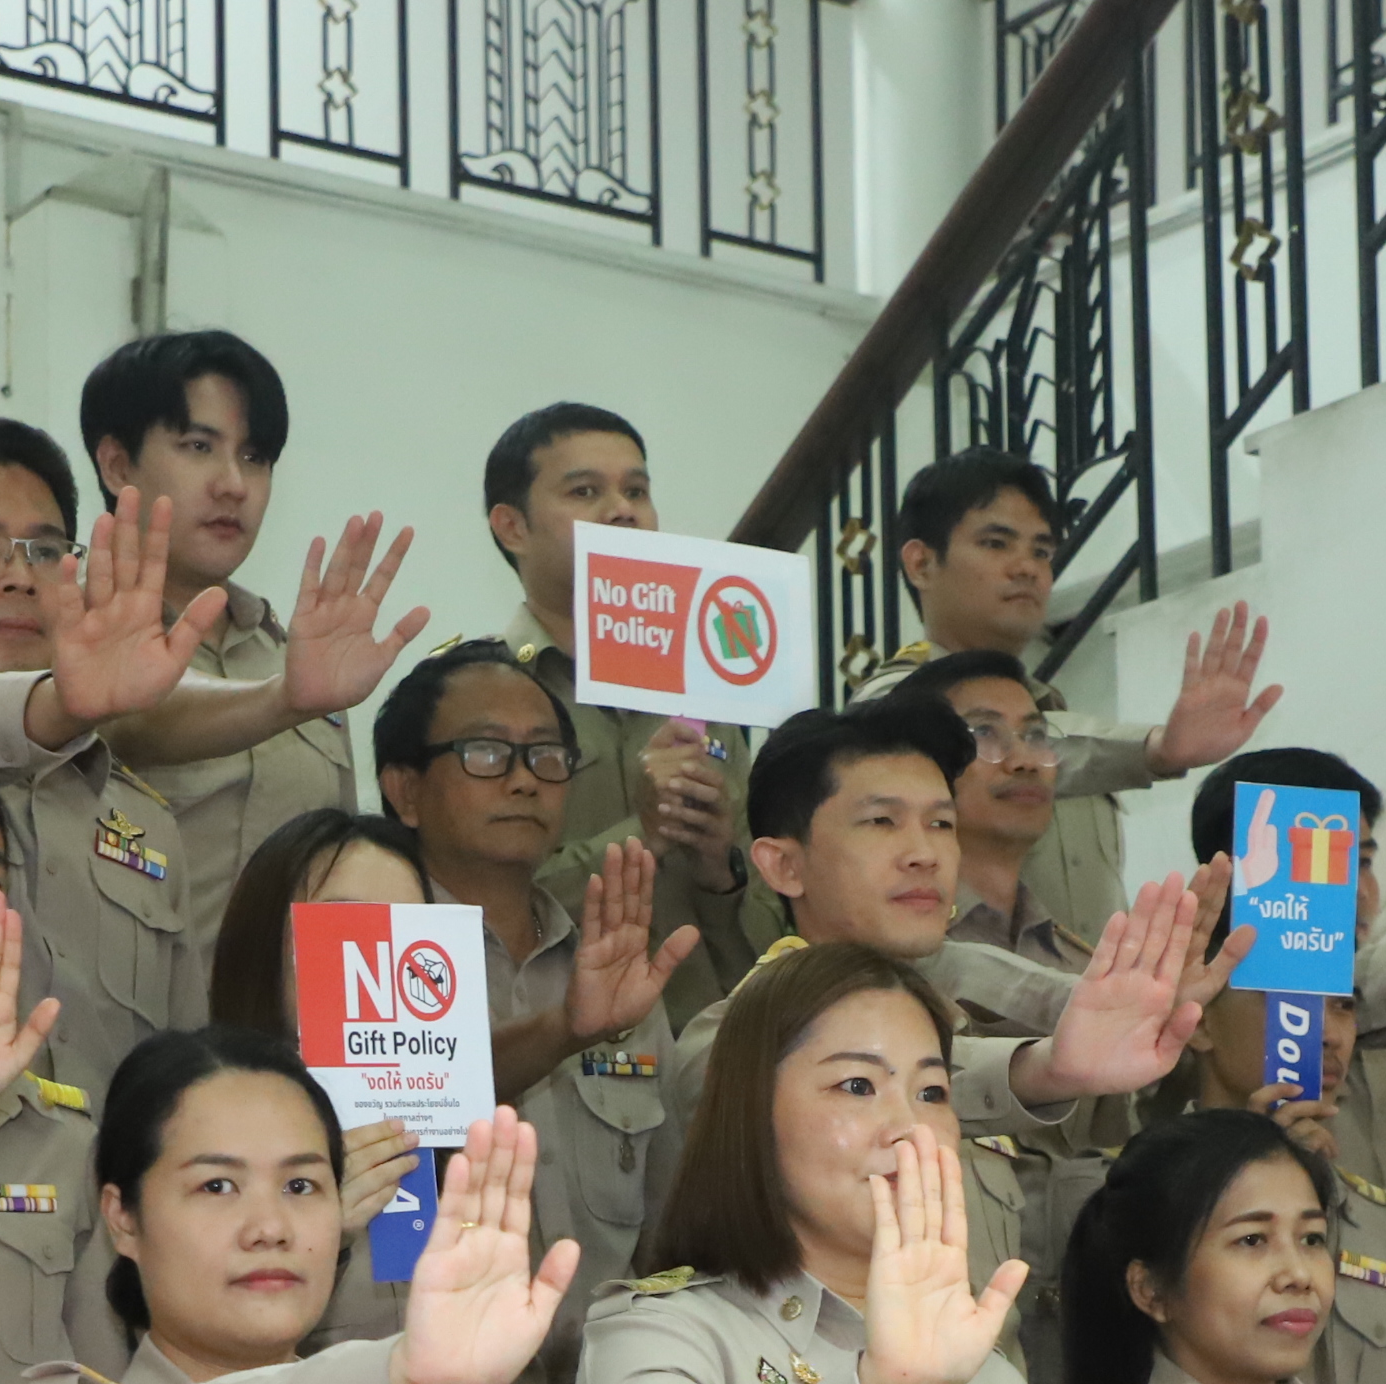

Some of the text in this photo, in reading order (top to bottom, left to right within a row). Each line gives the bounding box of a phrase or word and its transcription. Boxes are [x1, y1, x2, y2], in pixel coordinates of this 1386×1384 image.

[592, 576, 676, 614] No Gift
[596, 613, 674, 656] Policy
[347, 1030, 457, 1061] Gift Policy
[1277, 1000, 1310, 1109] Dou
